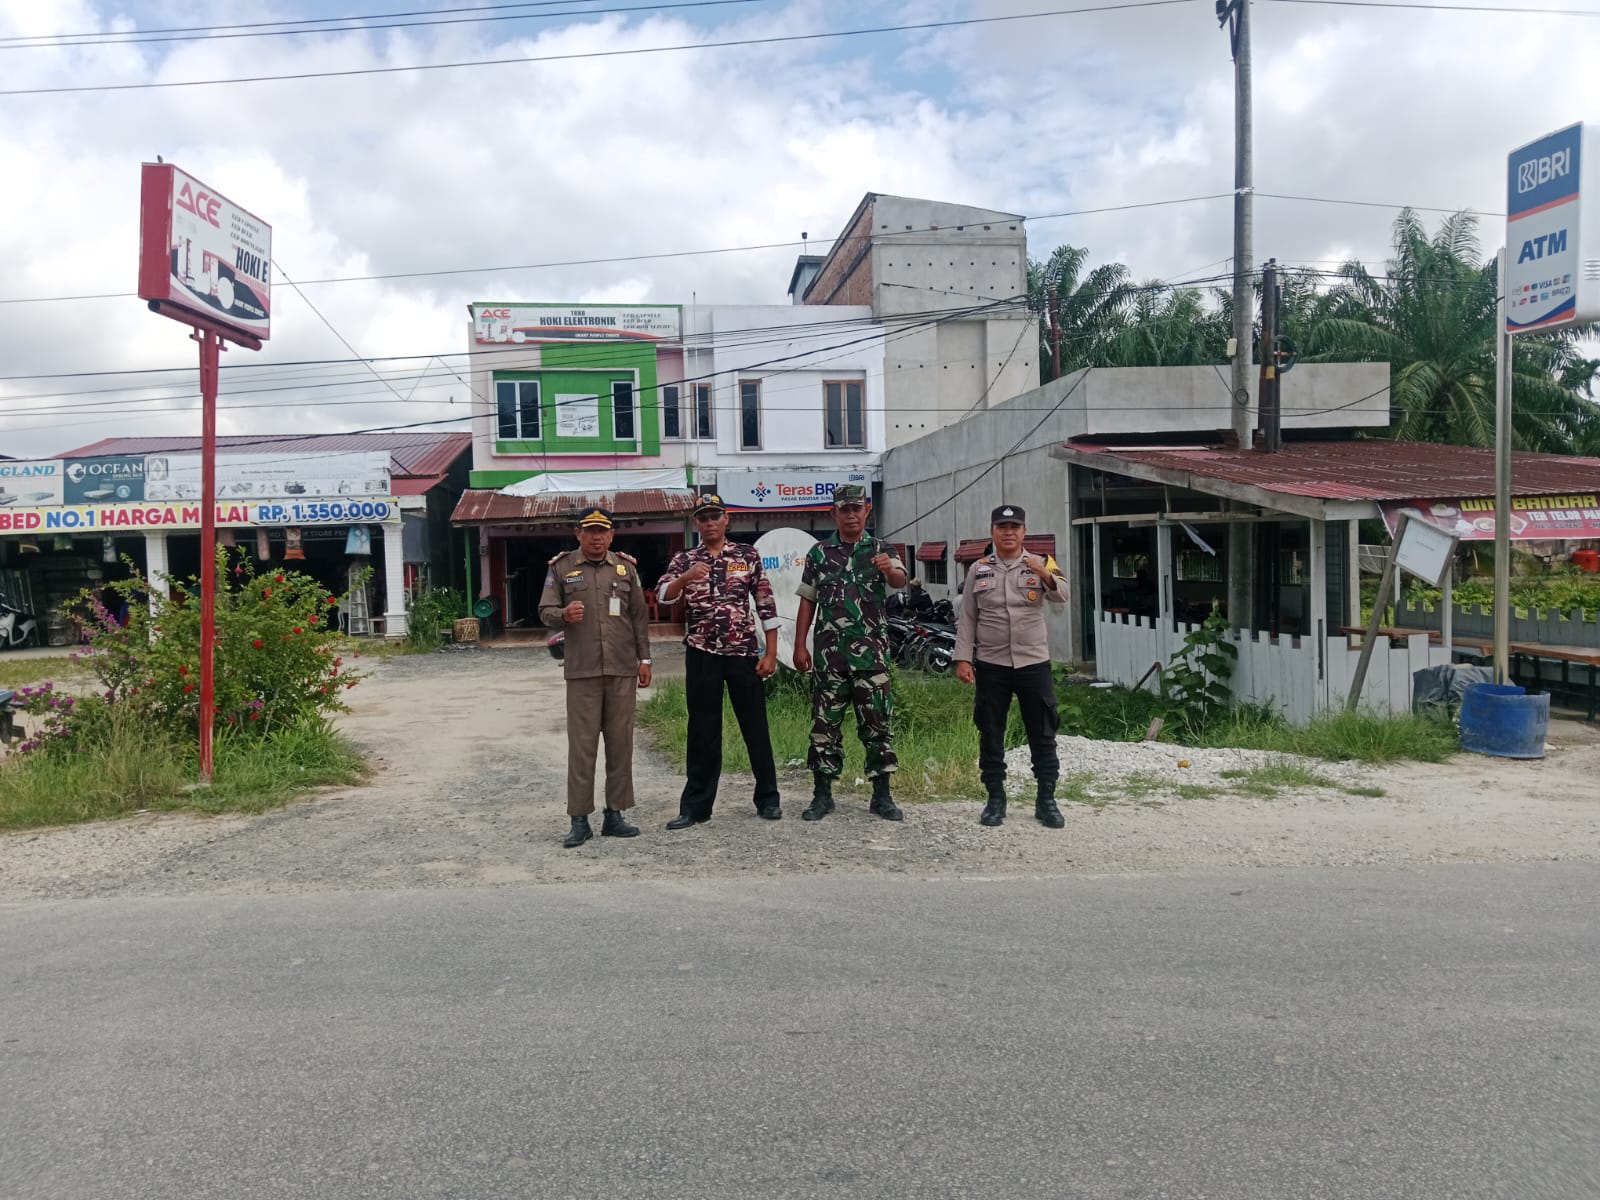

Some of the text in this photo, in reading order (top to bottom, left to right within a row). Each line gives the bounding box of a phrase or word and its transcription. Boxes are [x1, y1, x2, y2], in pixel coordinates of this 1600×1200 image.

[1538, 147, 1570, 185] BRI
[176, 182, 222, 229] ACE
[1517, 229, 1567, 264] ATM
[235, 247, 260, 280] HOKI
[481, 309, 512, 318] ACE
[540, 316, 616, 326] HOKI ELEKTRONIK
[89, 463, 142, 475] OCEAN
[776, 484, 813, 496] Teras
[0, 502, 388, 530] BED NO.1 HARGA MLAI RP. 1.350.000
[762, 556, 779, 569] BRI
